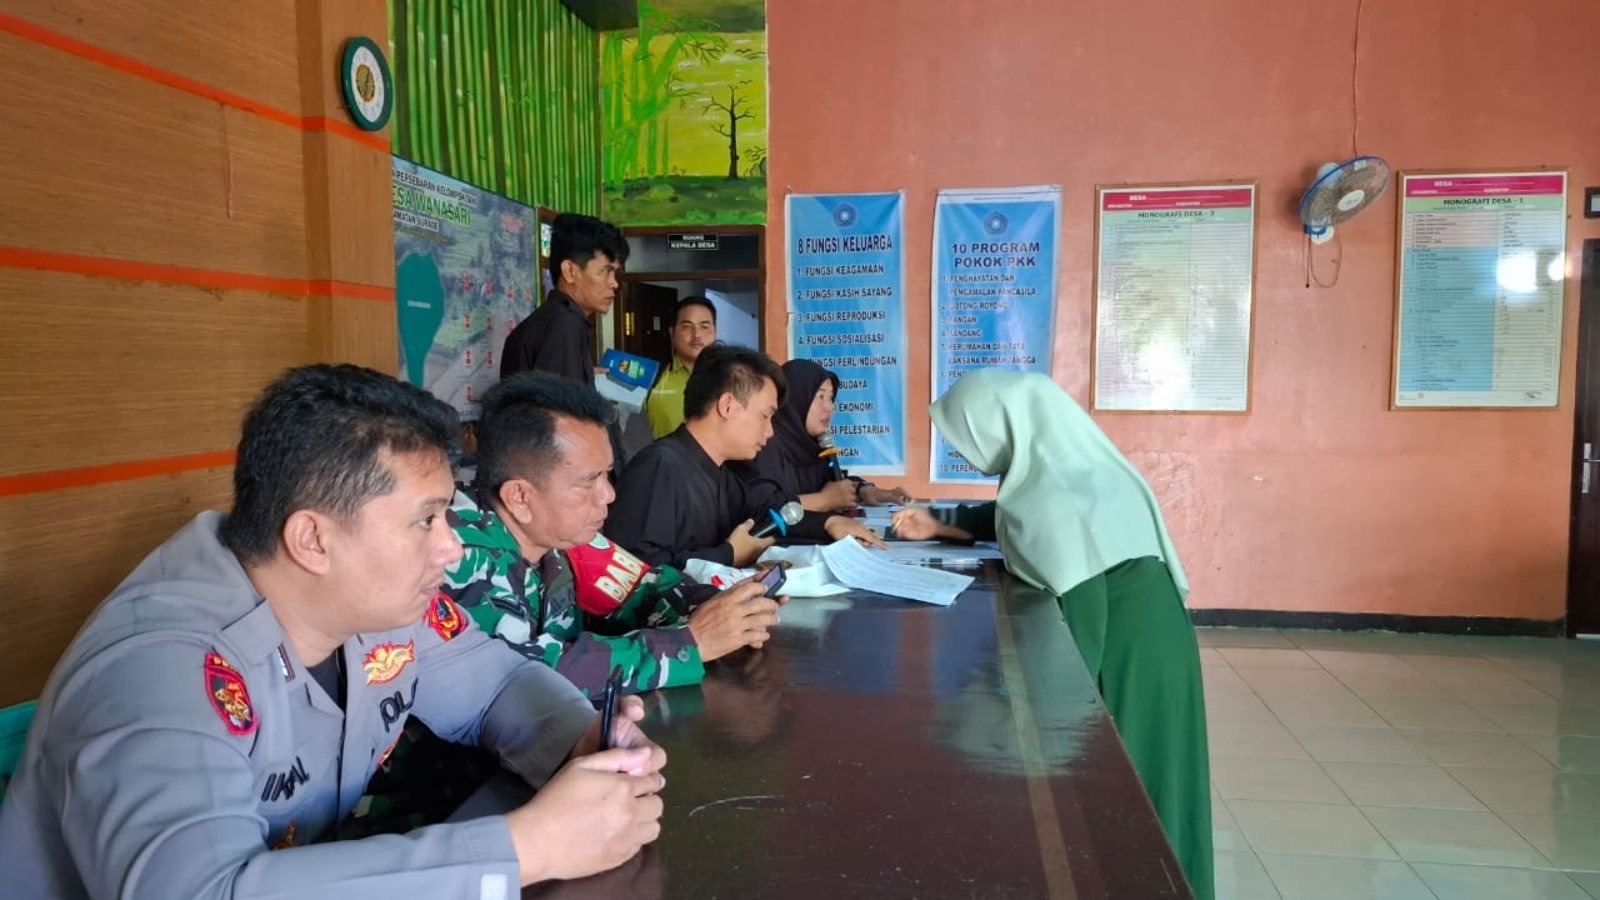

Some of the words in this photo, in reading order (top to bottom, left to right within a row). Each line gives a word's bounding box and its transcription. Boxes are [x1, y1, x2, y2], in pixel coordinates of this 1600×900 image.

[1443, 198, 1490, 206] MONOGRAFI
[1492, 197, 1512, 205] DESA
[414, 191, 471, 226] WANASARI
[1138, 210, 1182, 219] MONOGRAFI
[798, 238, 804, 255] 8
[806, 237, 840, 254] FUNGSI
[843, 234, 893, 252] KELUARGA
[952, 243, 967, 254] 10
[971, 242, 1040, 253] PROGRAM
[954, 257, 1002, 267] POKOK
[1007, 256, 1036, 267] PKK
[805, 266, 833, 277] FUNGSI
[835, 264, 884, 275] KEAGAMAAN
[949, 274, 998, 282] PENGHAYATAN
[1000, 274, 1015, 282] DAN
[806, 289, 834, 299] FUNGSI
[836, 288, 860, 298] KASIH
[862, 286, 892, 297] SAYANG
[949, 288, 996, 296] PENGAMALAN
[998, 287, 1036, 296] PANCASILA
[949, 302, 978, 310] GOTONG
[979, 301, 1009, 310] ROYONG
[806, 312, 835, 322] FUNGSI
[837, 310, 886, 321] REPRODUKSI
[949, 315, 977, 323] PANGAN
[949, 329, 981, 337] SANDANG
[807, 335, 836, 345] FUNGSI
[838, 333, 885, 343] SOSIALISASI
[948, 342, 991, 351] PERUMAHAN
[1009, 342, 1026, 350] TATA
[838, 356, 897, 367] PERLINDUNGAN
[948, 356, 980, 364] LAKSANA
[1008, 356, 1036, 364] TANGGA
[839, 379, 868, 390] BUDAYA
[839, 402, 874, 412] EKONOMI
[839, 425, 890, 435] PELESTARIAN
